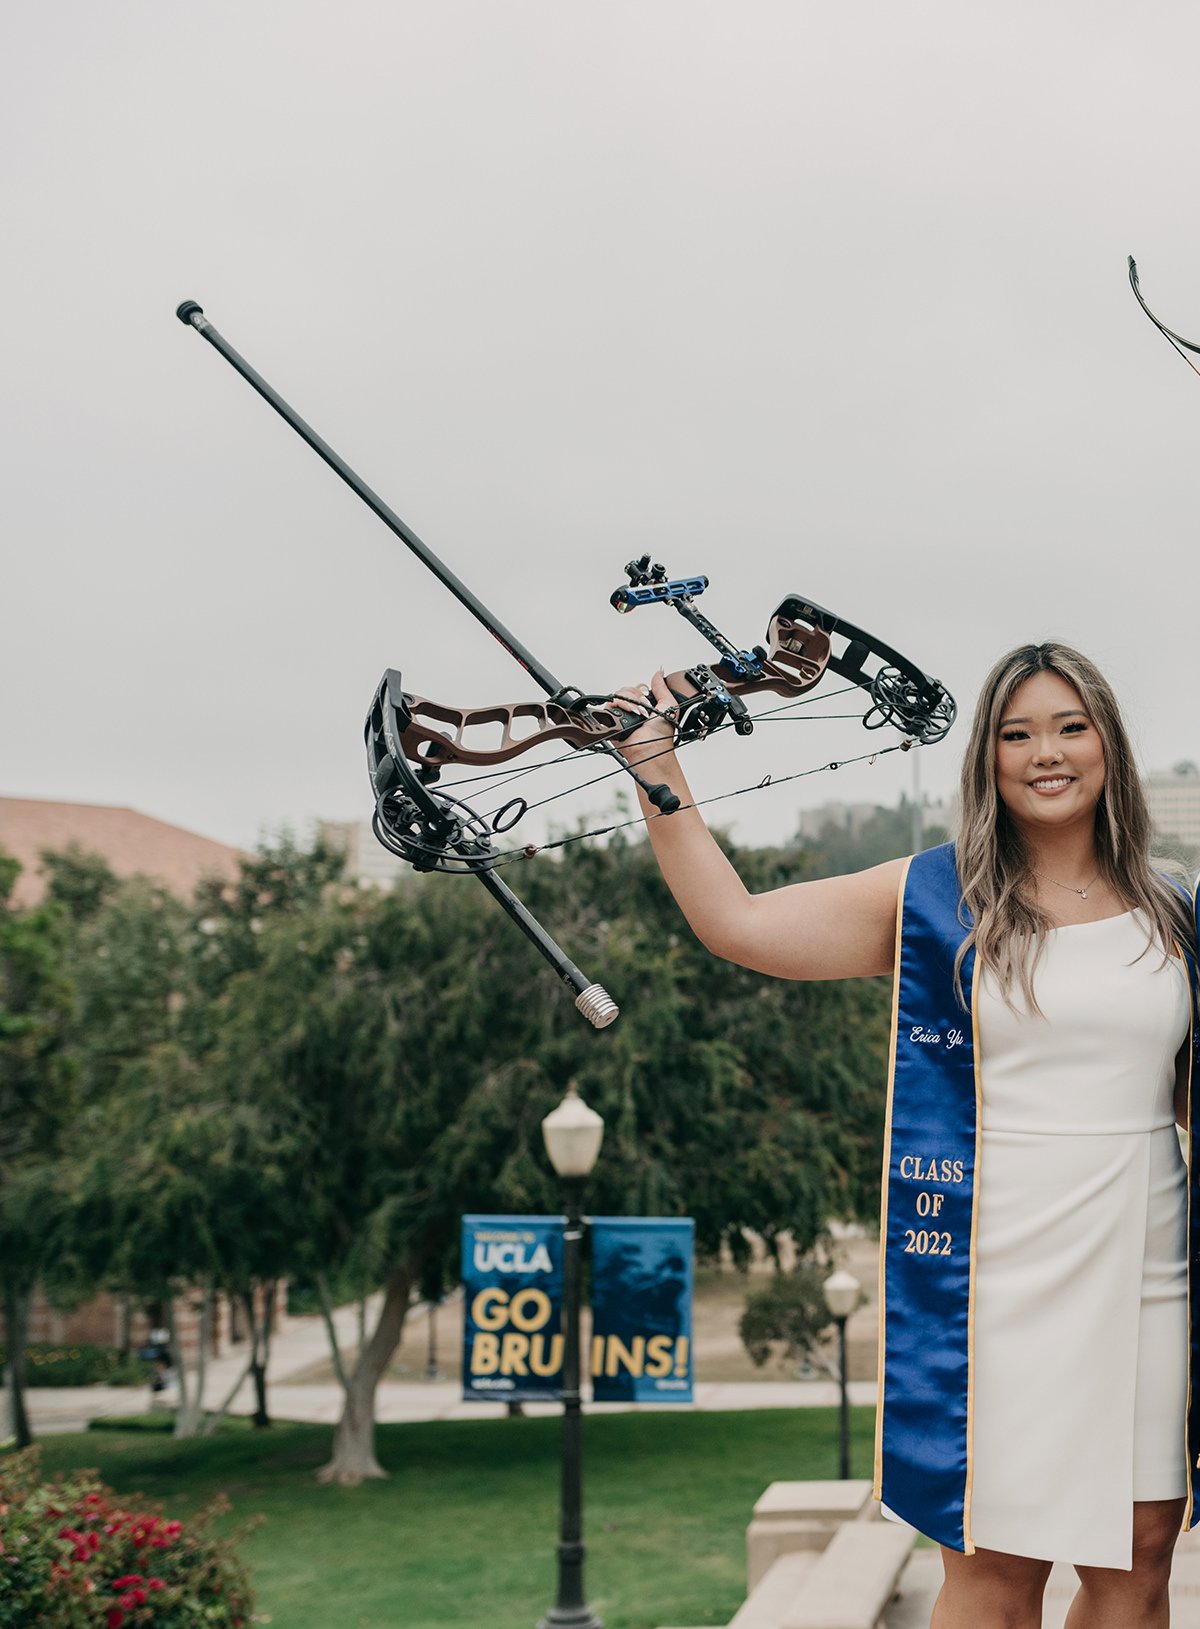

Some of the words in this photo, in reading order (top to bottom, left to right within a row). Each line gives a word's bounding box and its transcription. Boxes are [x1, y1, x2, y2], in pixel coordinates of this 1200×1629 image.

[909, 1026, 941, 1043] Erica
[946, 1029, 964, 1049] Yu
[899, 1155, 965, 1183] CLASS
[916, 1192, 944, 1217] OF
[904, 1229, 953, 1256] 2022
[473, 1243, 553, 1274] UCLA
[471, 1287, 552, 1333] GO
